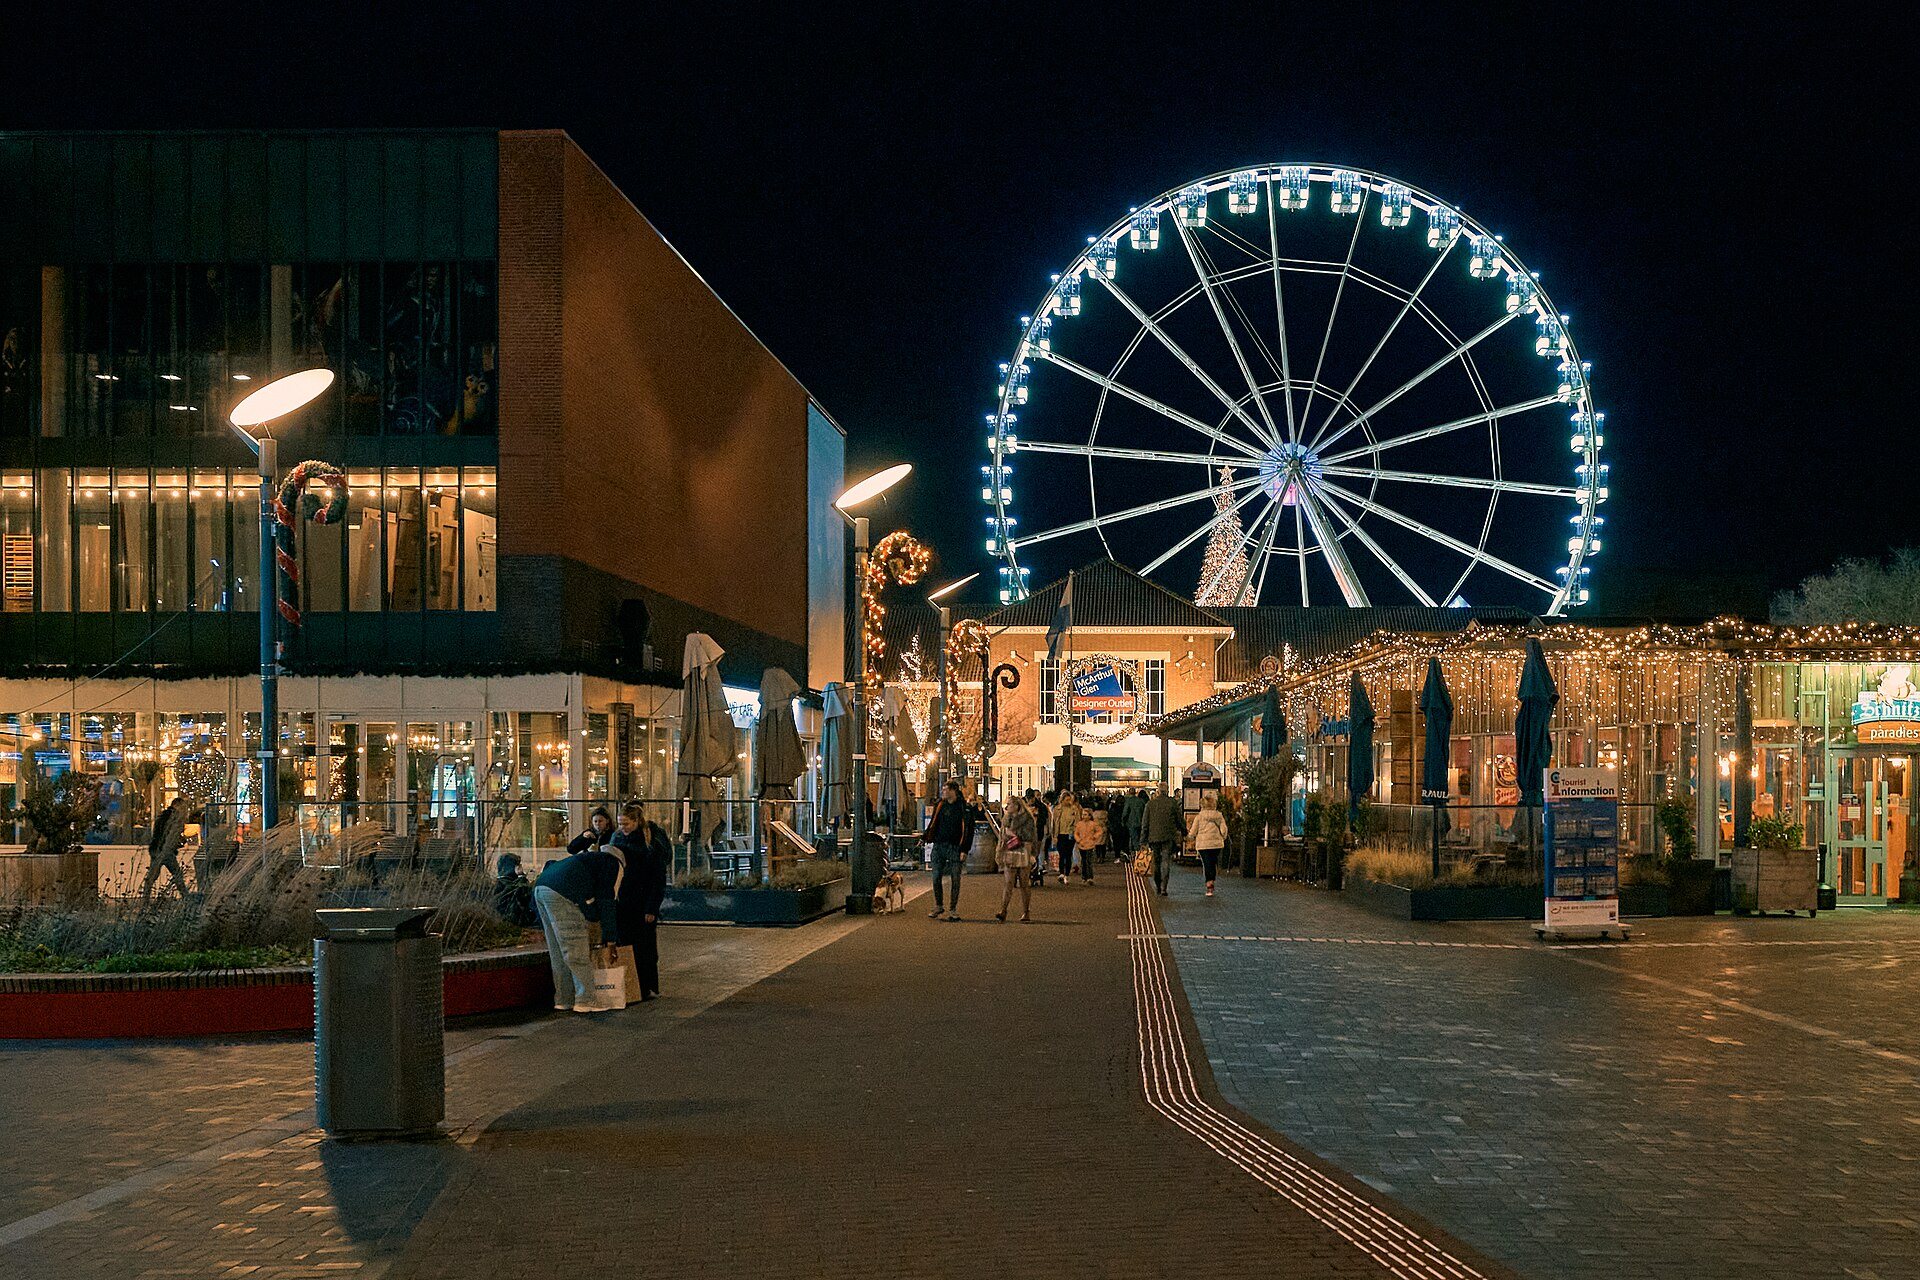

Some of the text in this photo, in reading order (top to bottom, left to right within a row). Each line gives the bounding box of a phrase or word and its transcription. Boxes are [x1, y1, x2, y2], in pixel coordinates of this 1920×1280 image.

[1077, 669, 1113, 688] McArthur
[1080, 684, 1100, 696] Glen
[1072, 699, 1133, 709] Designer Outlet
[1871, 726, 1919, 740] paradies
